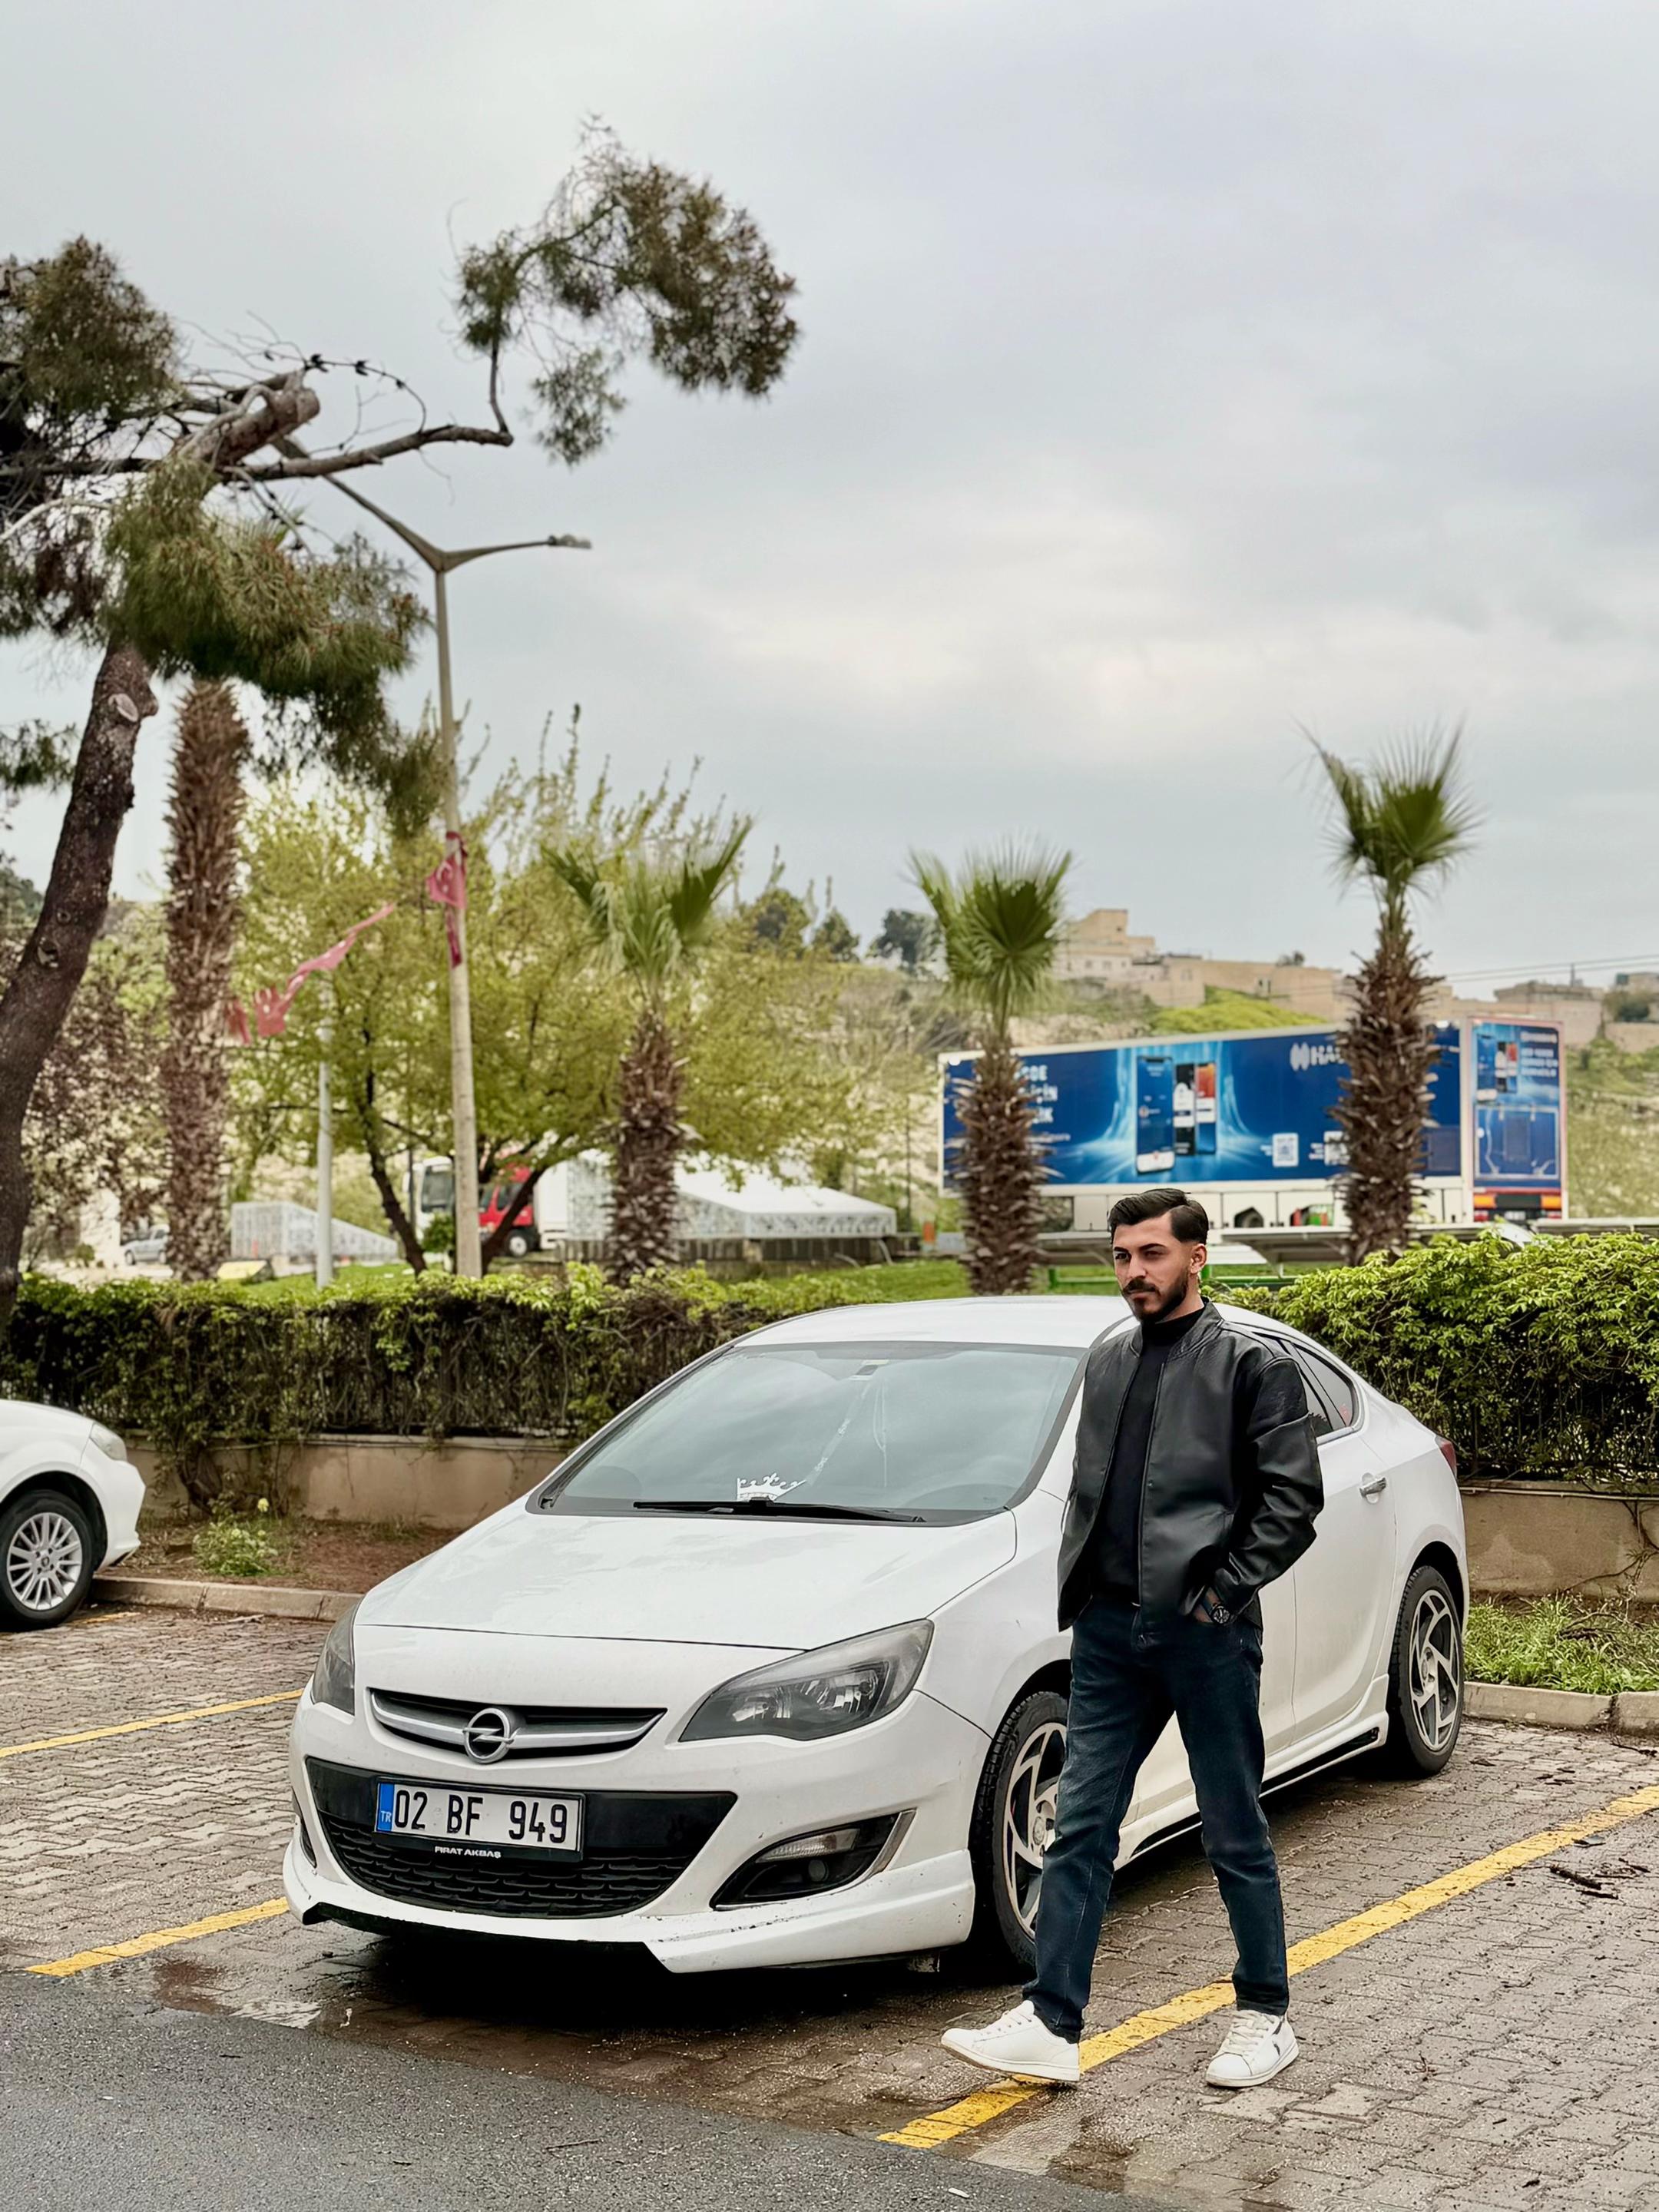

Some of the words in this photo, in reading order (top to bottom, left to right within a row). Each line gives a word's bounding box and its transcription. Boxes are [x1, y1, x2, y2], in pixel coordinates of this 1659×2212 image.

[380, 1810, 392, 1823] TR
[395, 1790, 428, 1830] 02
[446, 1794, 484, 1836] BF
[508, 1800, 568, 1843] 949
[434, 1846, 463, 1856] FIRAT
